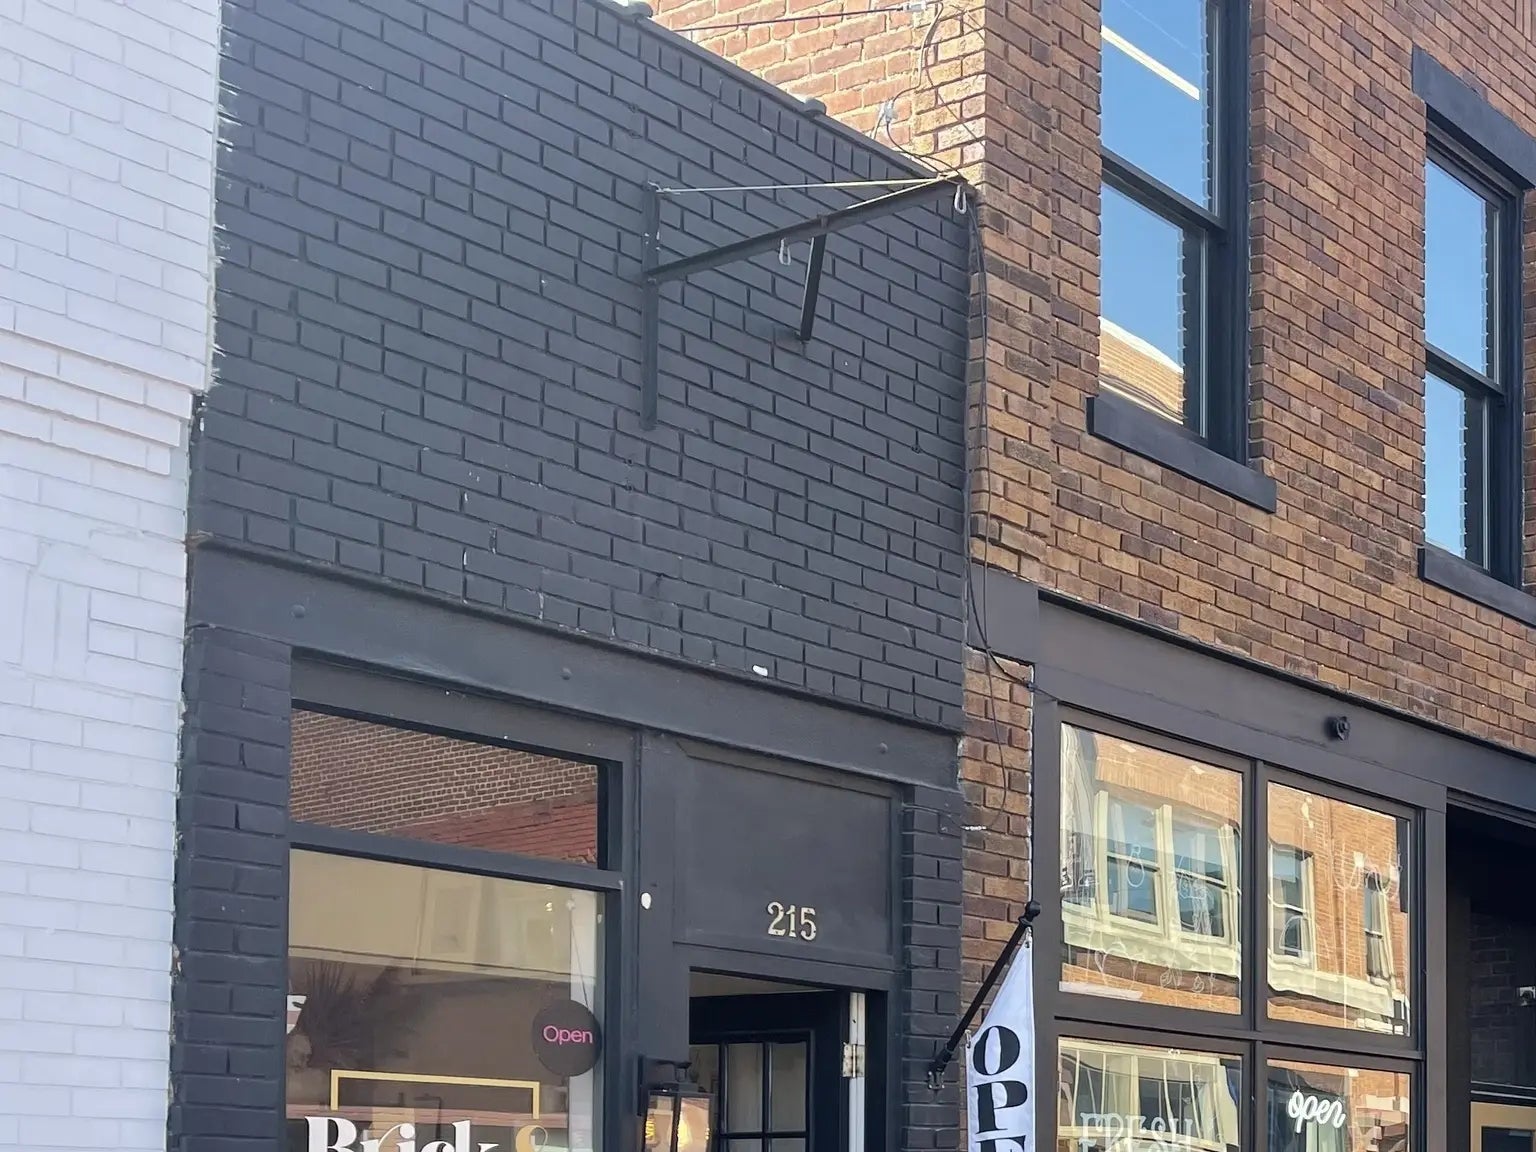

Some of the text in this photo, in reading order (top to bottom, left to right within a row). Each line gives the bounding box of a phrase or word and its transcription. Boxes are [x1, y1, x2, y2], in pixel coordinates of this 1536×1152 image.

[767, 901, 817, 941] 215
[543, 1025, 593, 1045] Open
[1287, 1089, 1346, 1133] open
